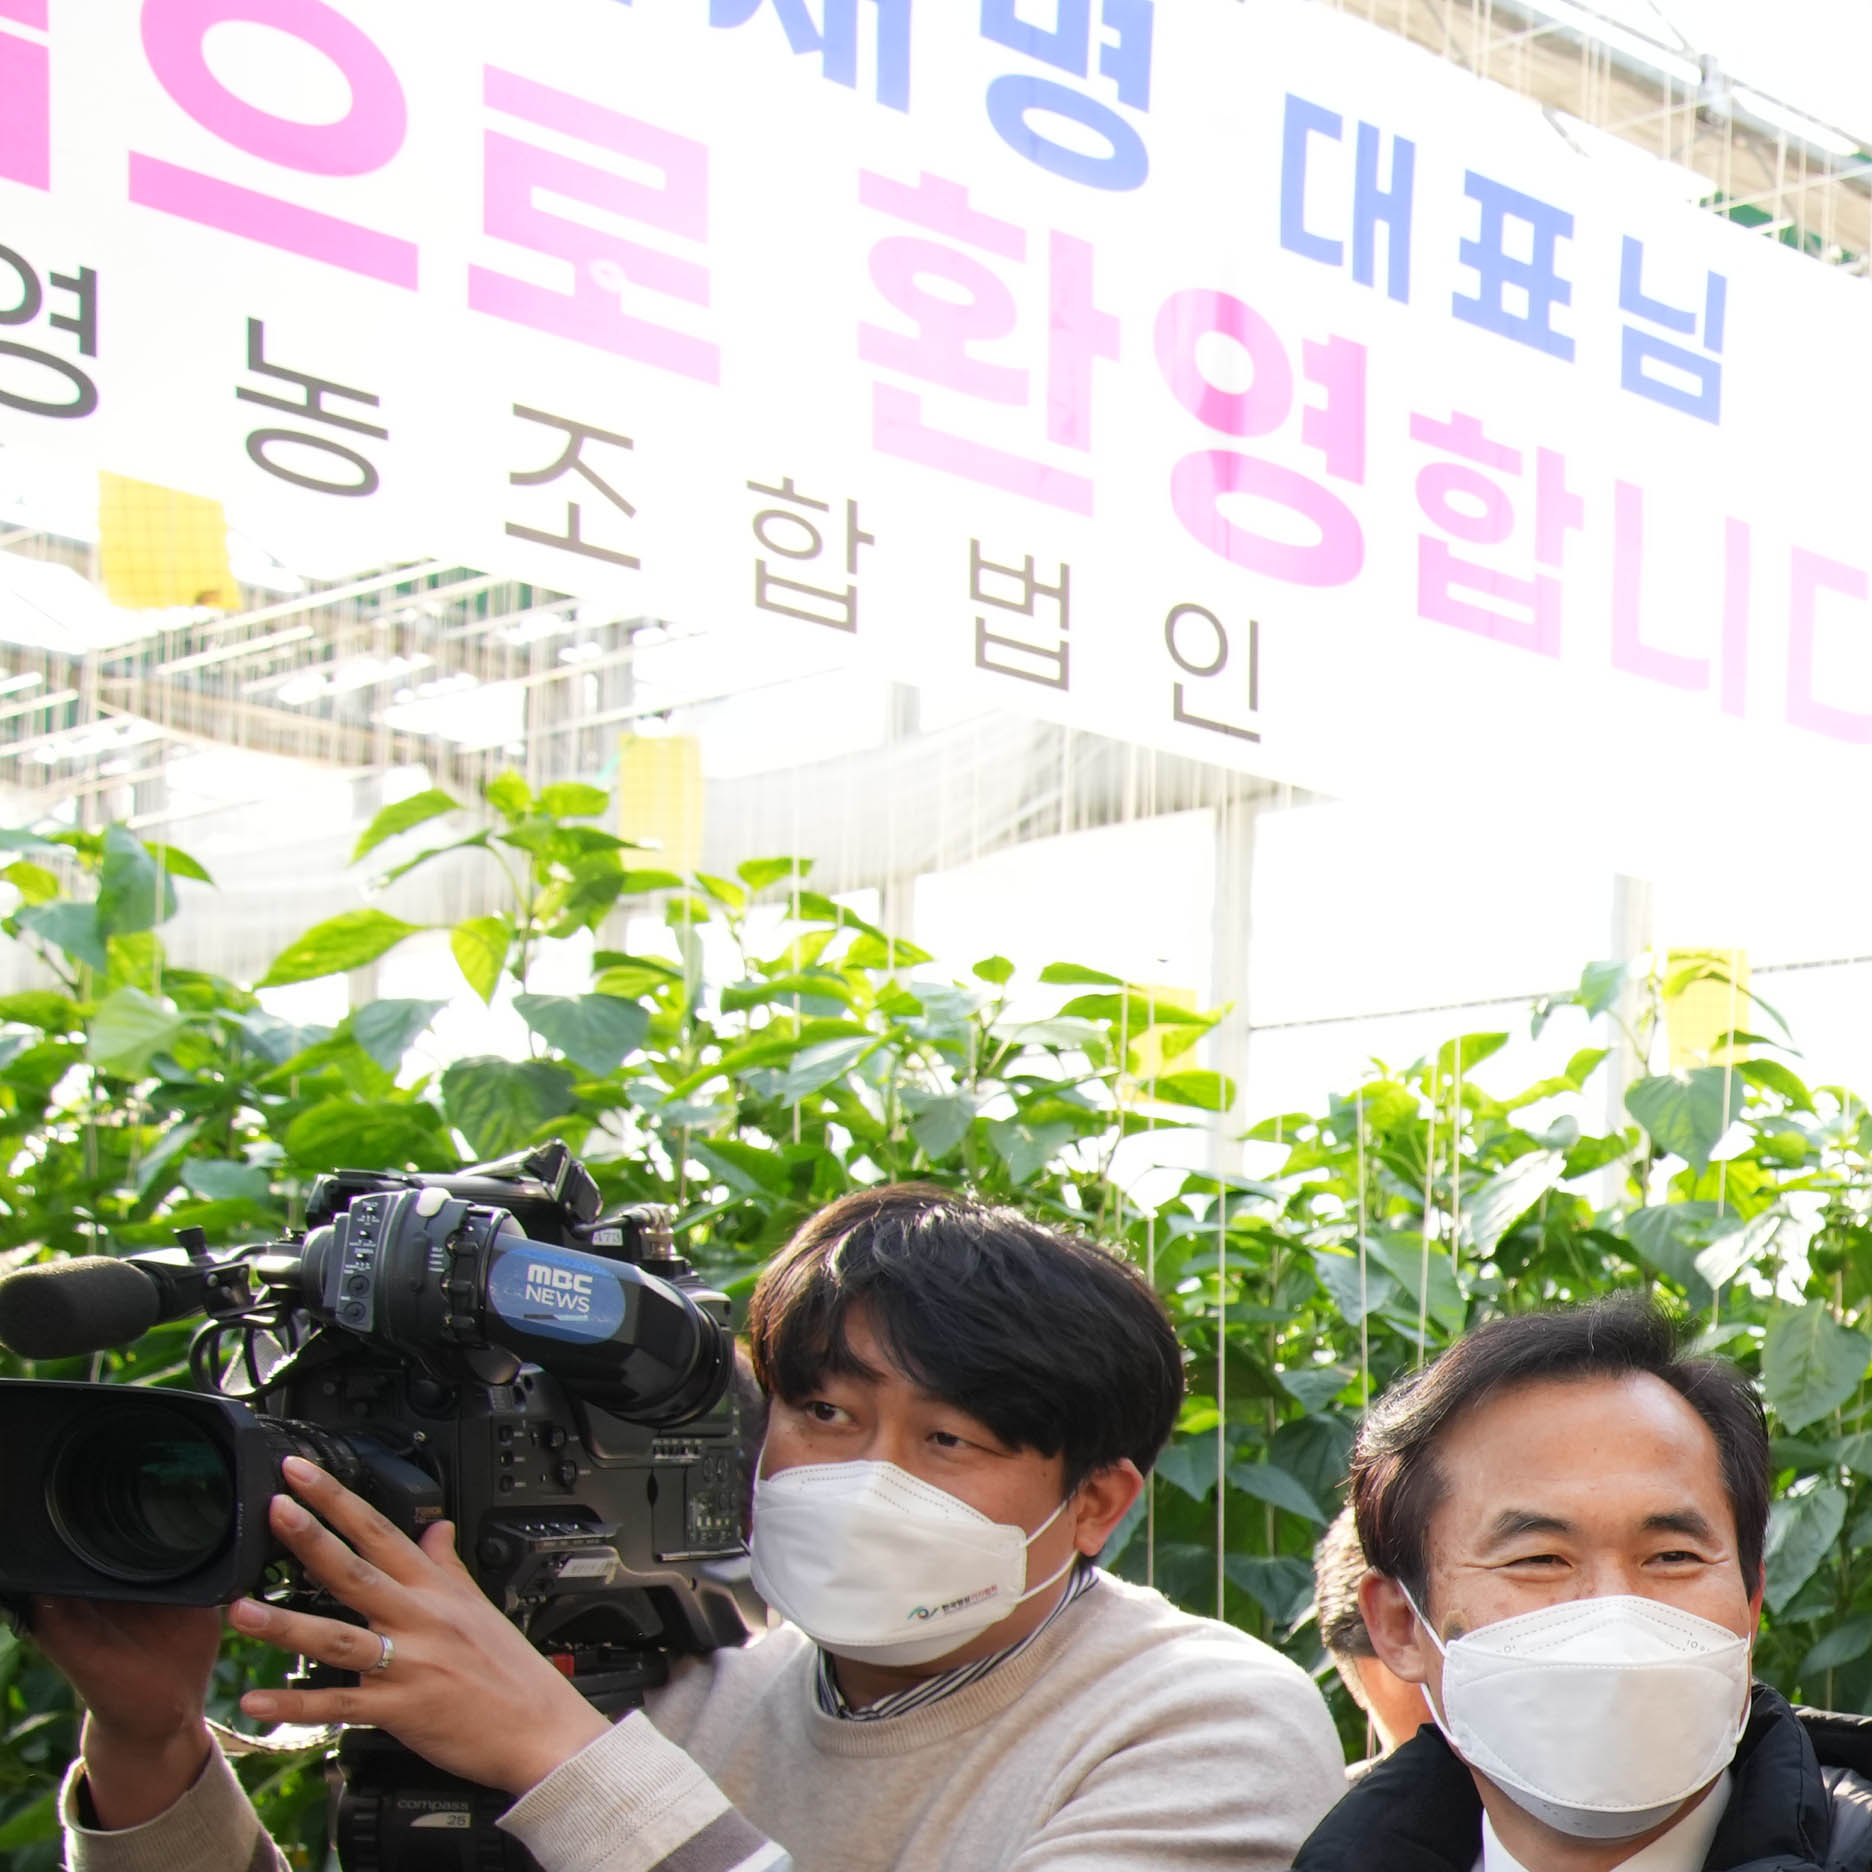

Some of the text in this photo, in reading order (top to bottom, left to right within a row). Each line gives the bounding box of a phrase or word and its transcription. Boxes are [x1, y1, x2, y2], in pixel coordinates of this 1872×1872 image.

[0, 0, 722, 388] 으로
[1279, 92, 1728, 427] 대표님
[527, 1263, 593, 1295] MBC
[525, 1284, 590, 1313] NEWS
[396, 1798, 469, 1812] compass
